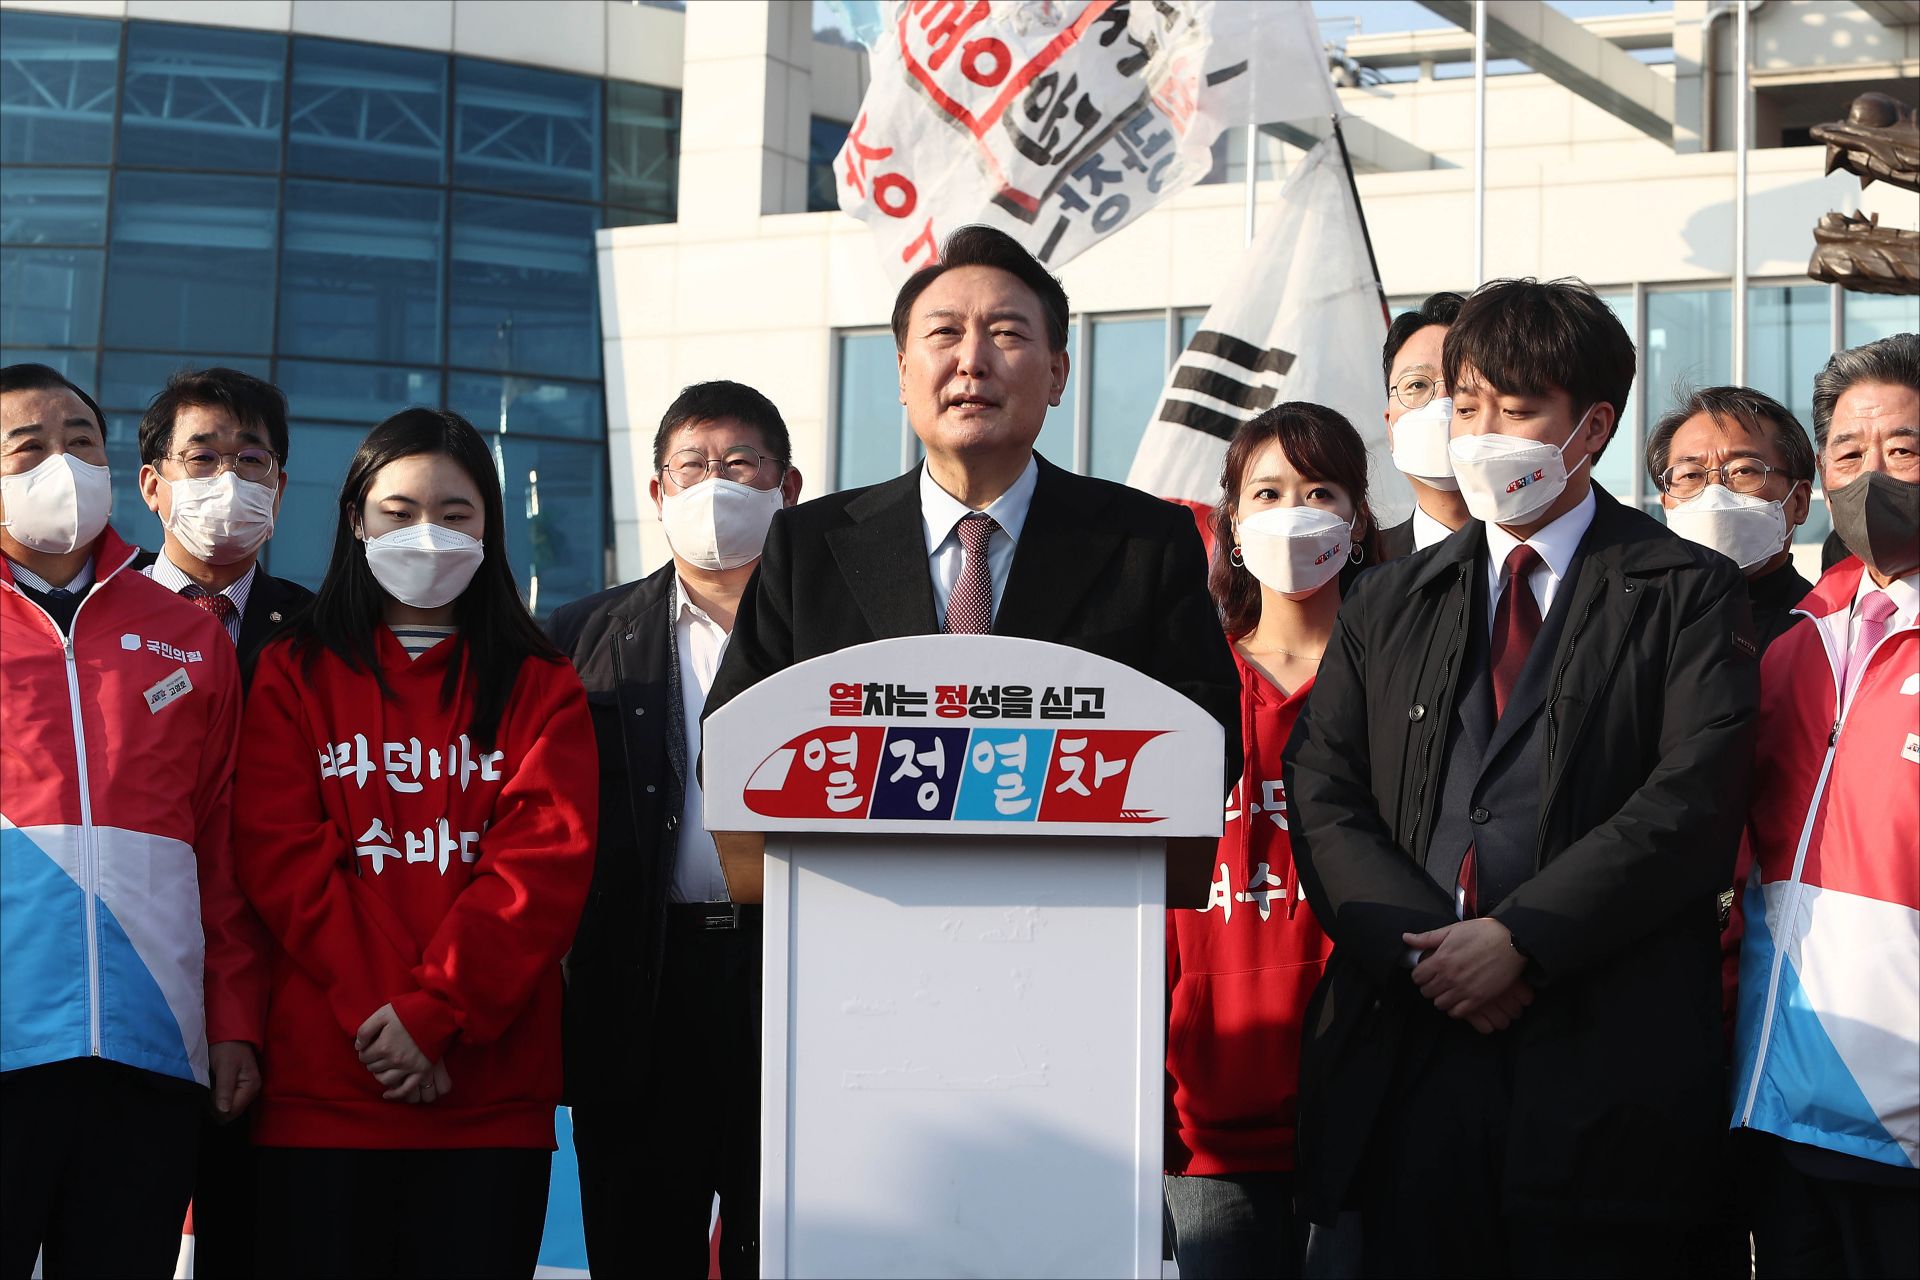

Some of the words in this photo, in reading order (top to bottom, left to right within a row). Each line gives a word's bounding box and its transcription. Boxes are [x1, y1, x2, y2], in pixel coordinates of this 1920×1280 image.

[146, 640, 203, 663] 국민의힘
[829, 683, 928, 717] 열차는
[934, 685, 1033, 720] 정성을
[1040, 686, 1106, 719] 싣고
[803, 731, 1127, 814] 열정열차
